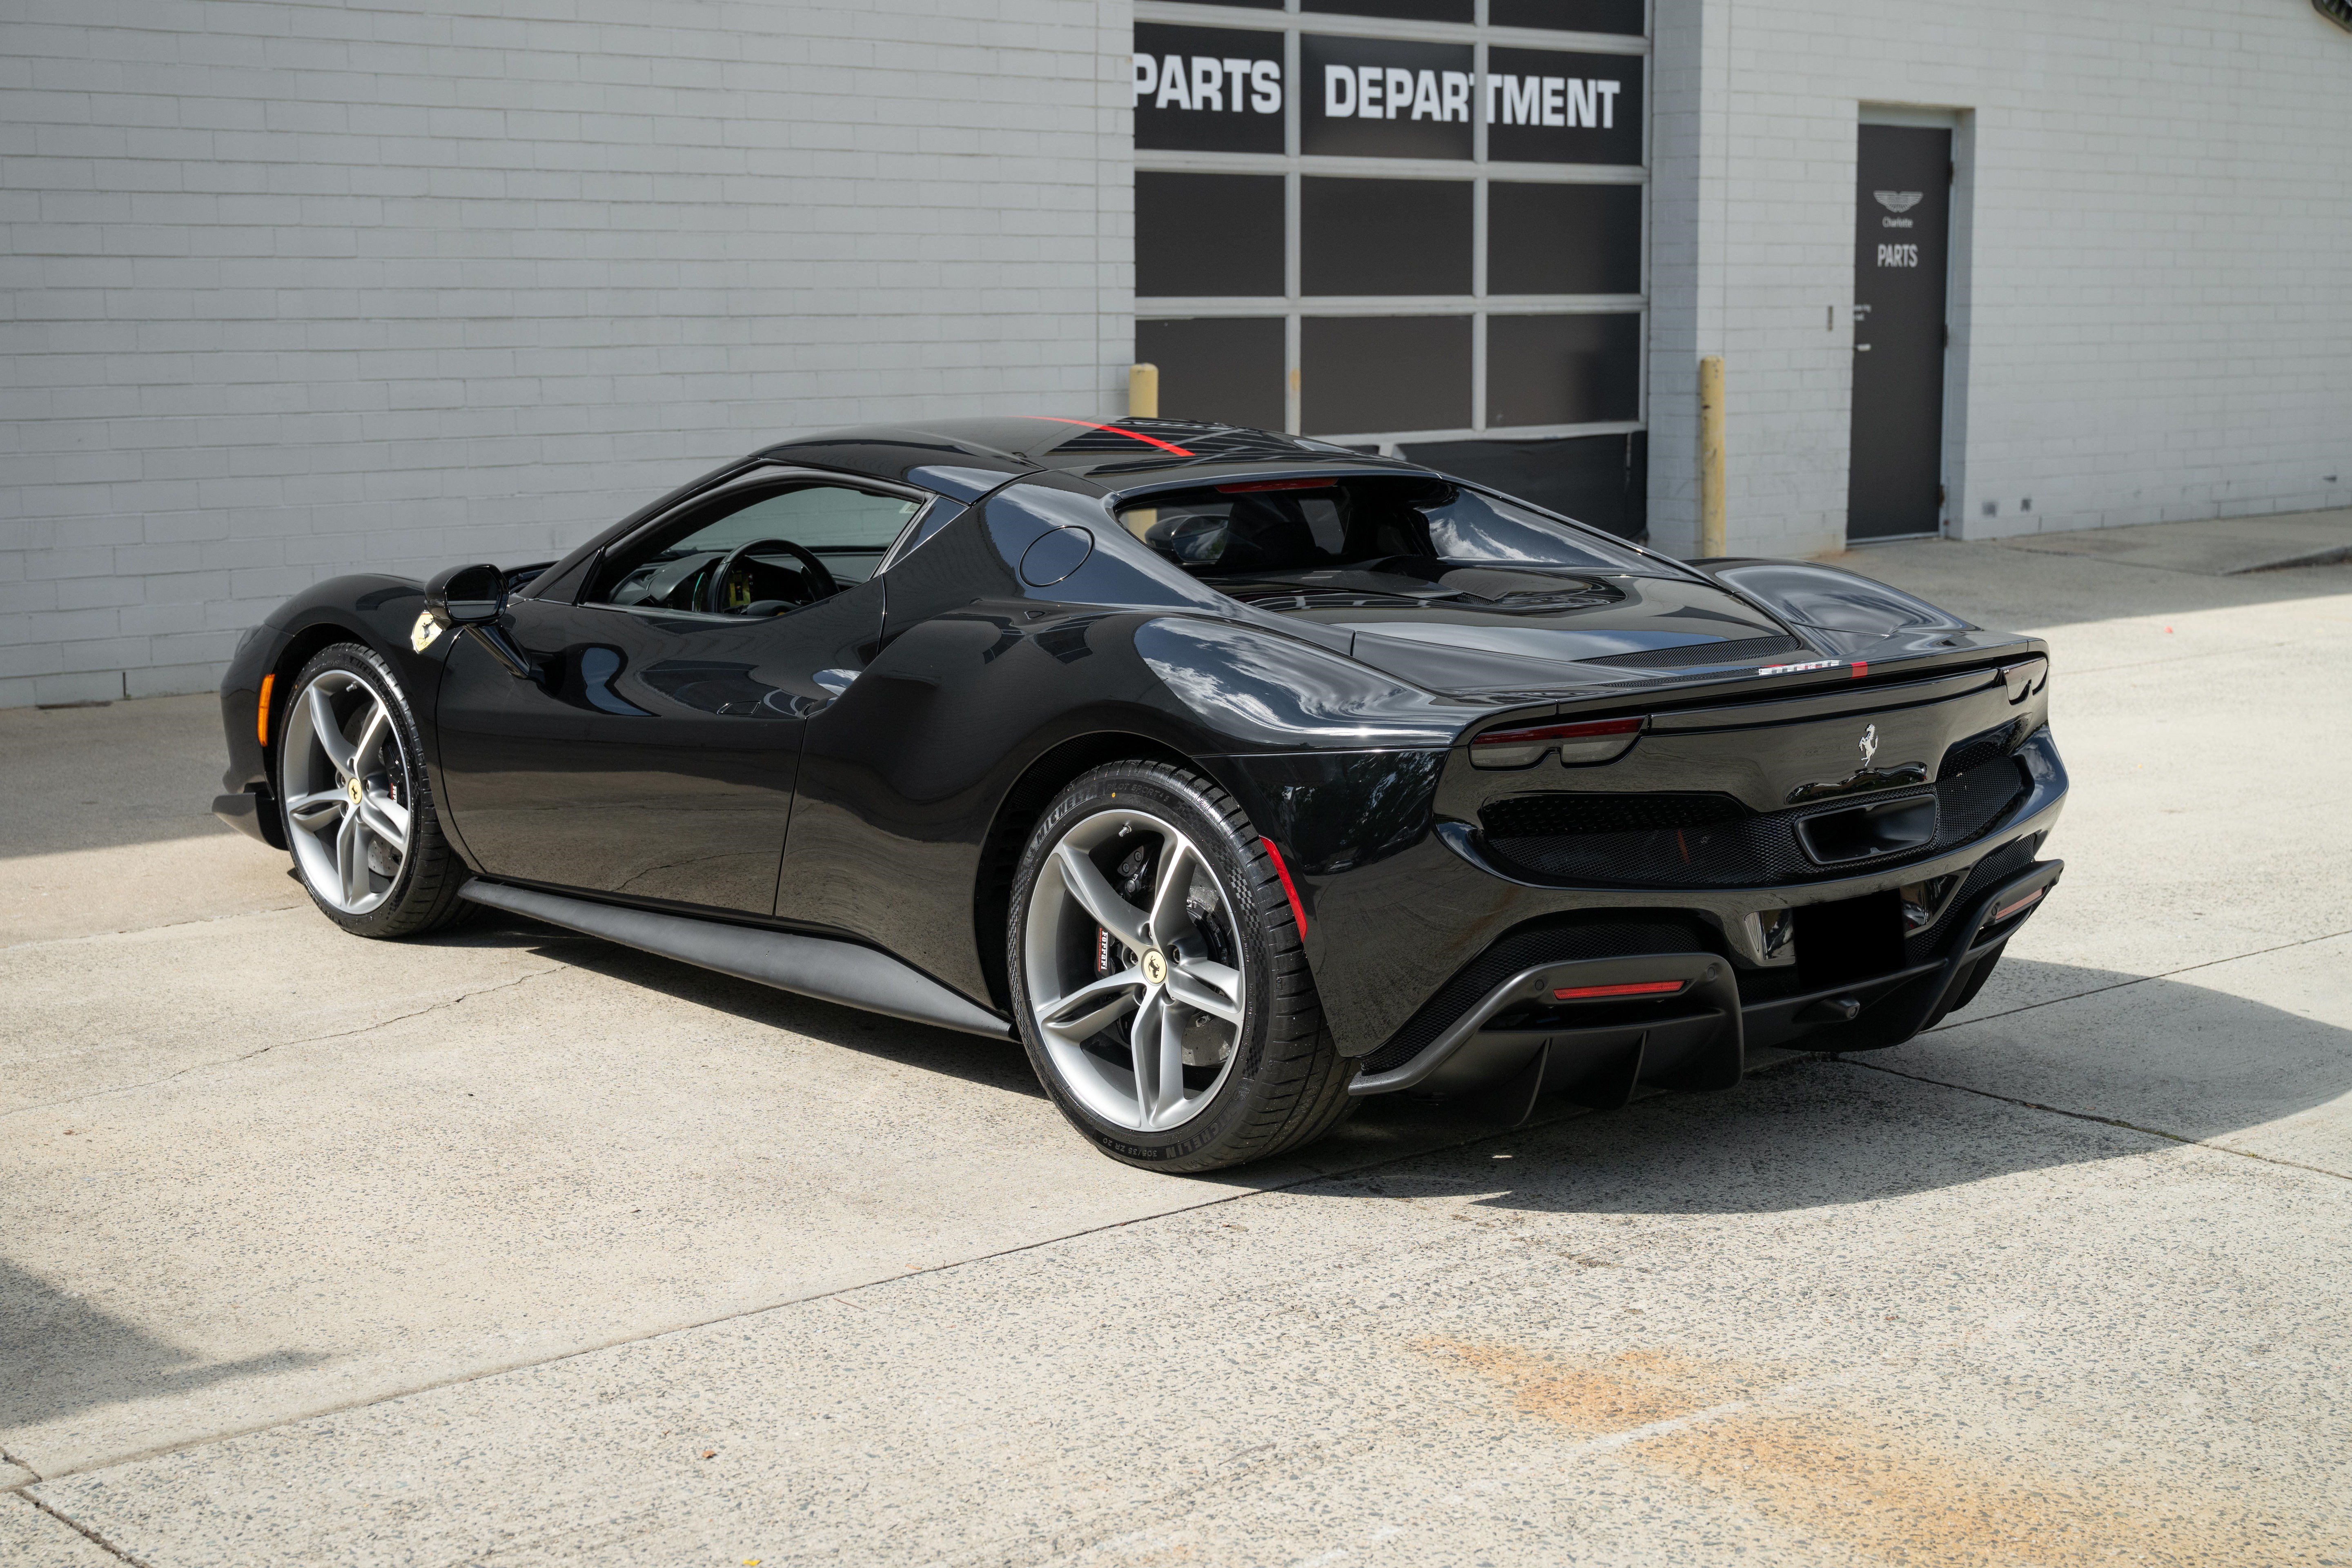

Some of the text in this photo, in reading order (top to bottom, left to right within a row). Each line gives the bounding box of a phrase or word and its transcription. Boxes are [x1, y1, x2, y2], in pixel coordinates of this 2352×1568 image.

[1133, 53, 1620, 129] PARTS DEPARTMENT
[1882, 216, 1913, 228] Charlotte
[1878, 244, 1918, 267] PARTS
[1106, 783, 1130, 791] PILOT
[1131, 784, 1160, 797] SPORT
[1036, 783, 1098, 844] MICHEL
[1103, 1138, 1158, 1157] 305/35 ZR 20
